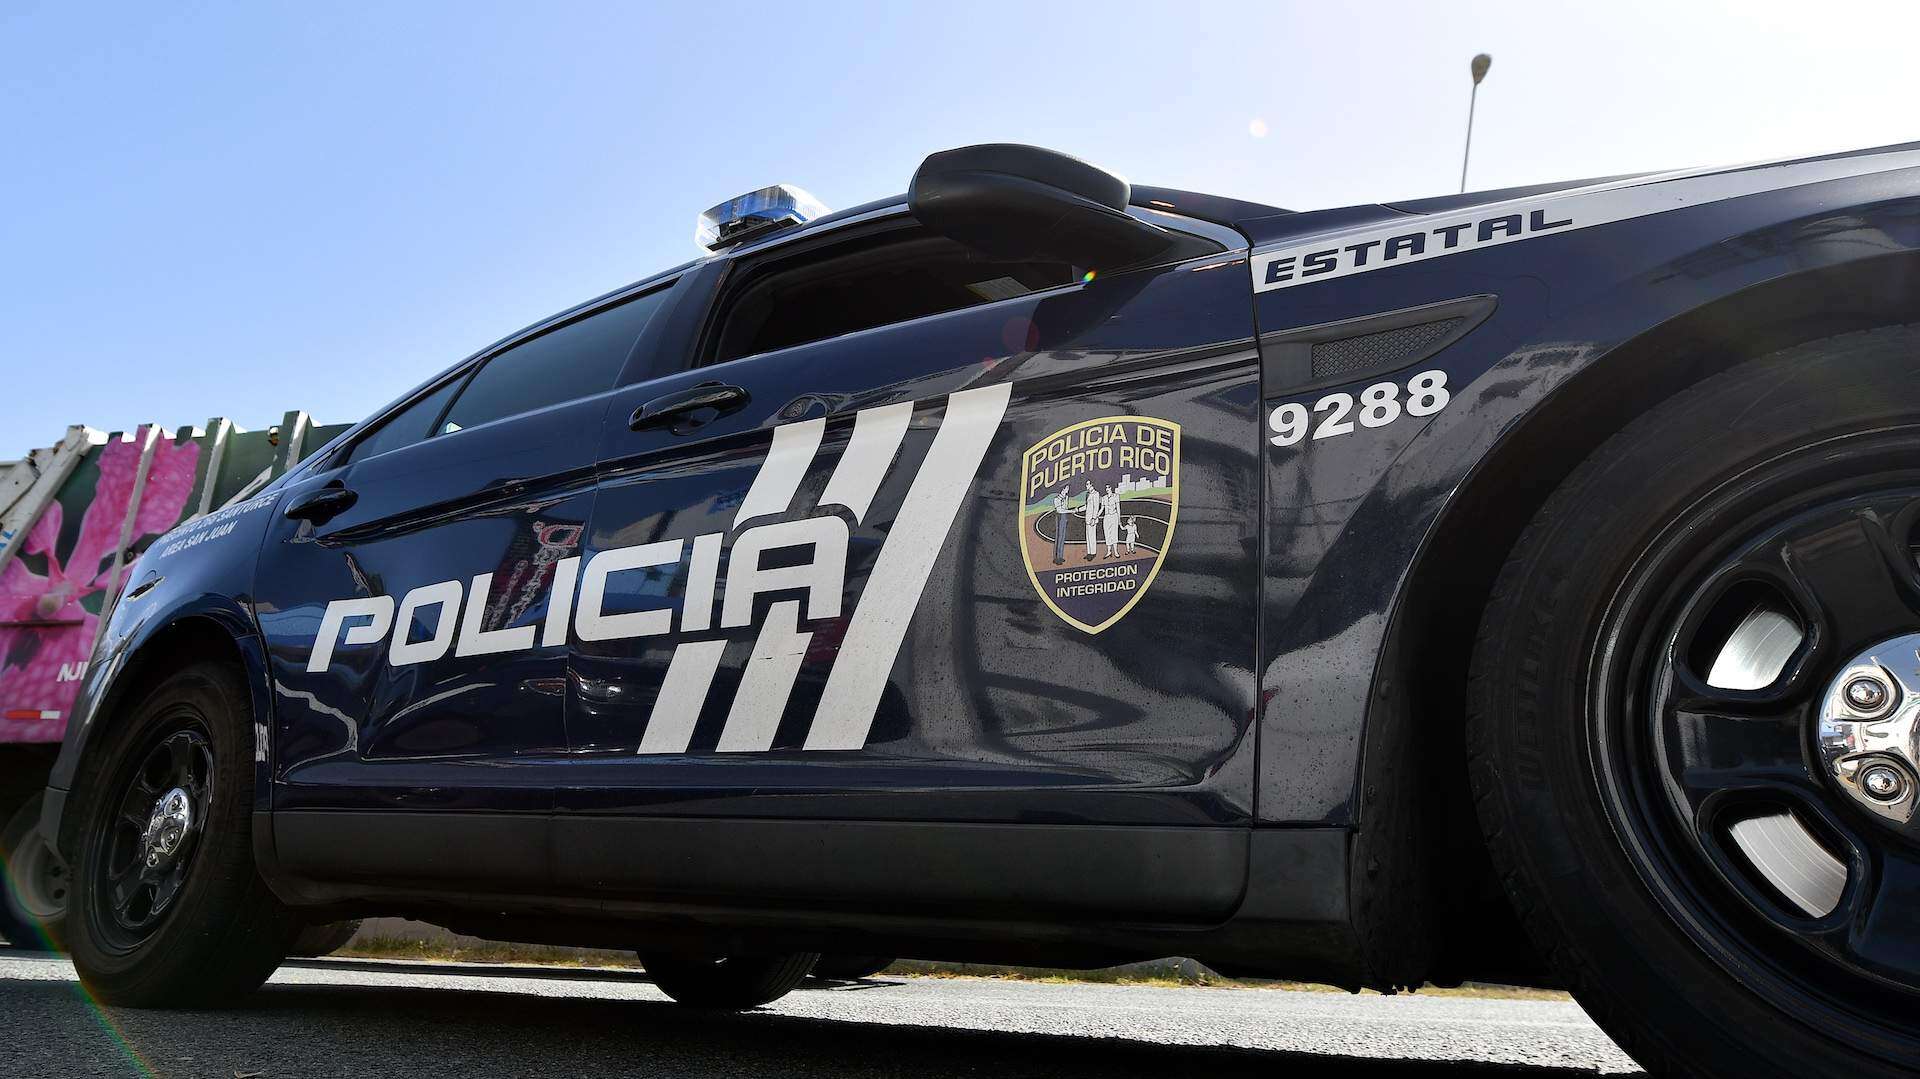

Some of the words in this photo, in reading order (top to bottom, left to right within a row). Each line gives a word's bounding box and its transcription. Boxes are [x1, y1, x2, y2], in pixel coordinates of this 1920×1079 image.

[1264, 209, 1573, 285] ESTATAL
[1268, 369, 1451, 447] 9288
[1030, 446, 1112, 498] PUERTO
[1119, 446, 1170, 476] RICO
[1031, 424, 1127, 473] POLICIA
[1136, 425, 1172, 452] DE
[183, 529, 210, 549] SAN
[204, 520, 239, 541] JUAN
[306, 514, 851, 673] POLICIA
[1055, 564, 1138, 584] PROTECCION
[1056, 579, 1136, 598] INTEGRIDAD
